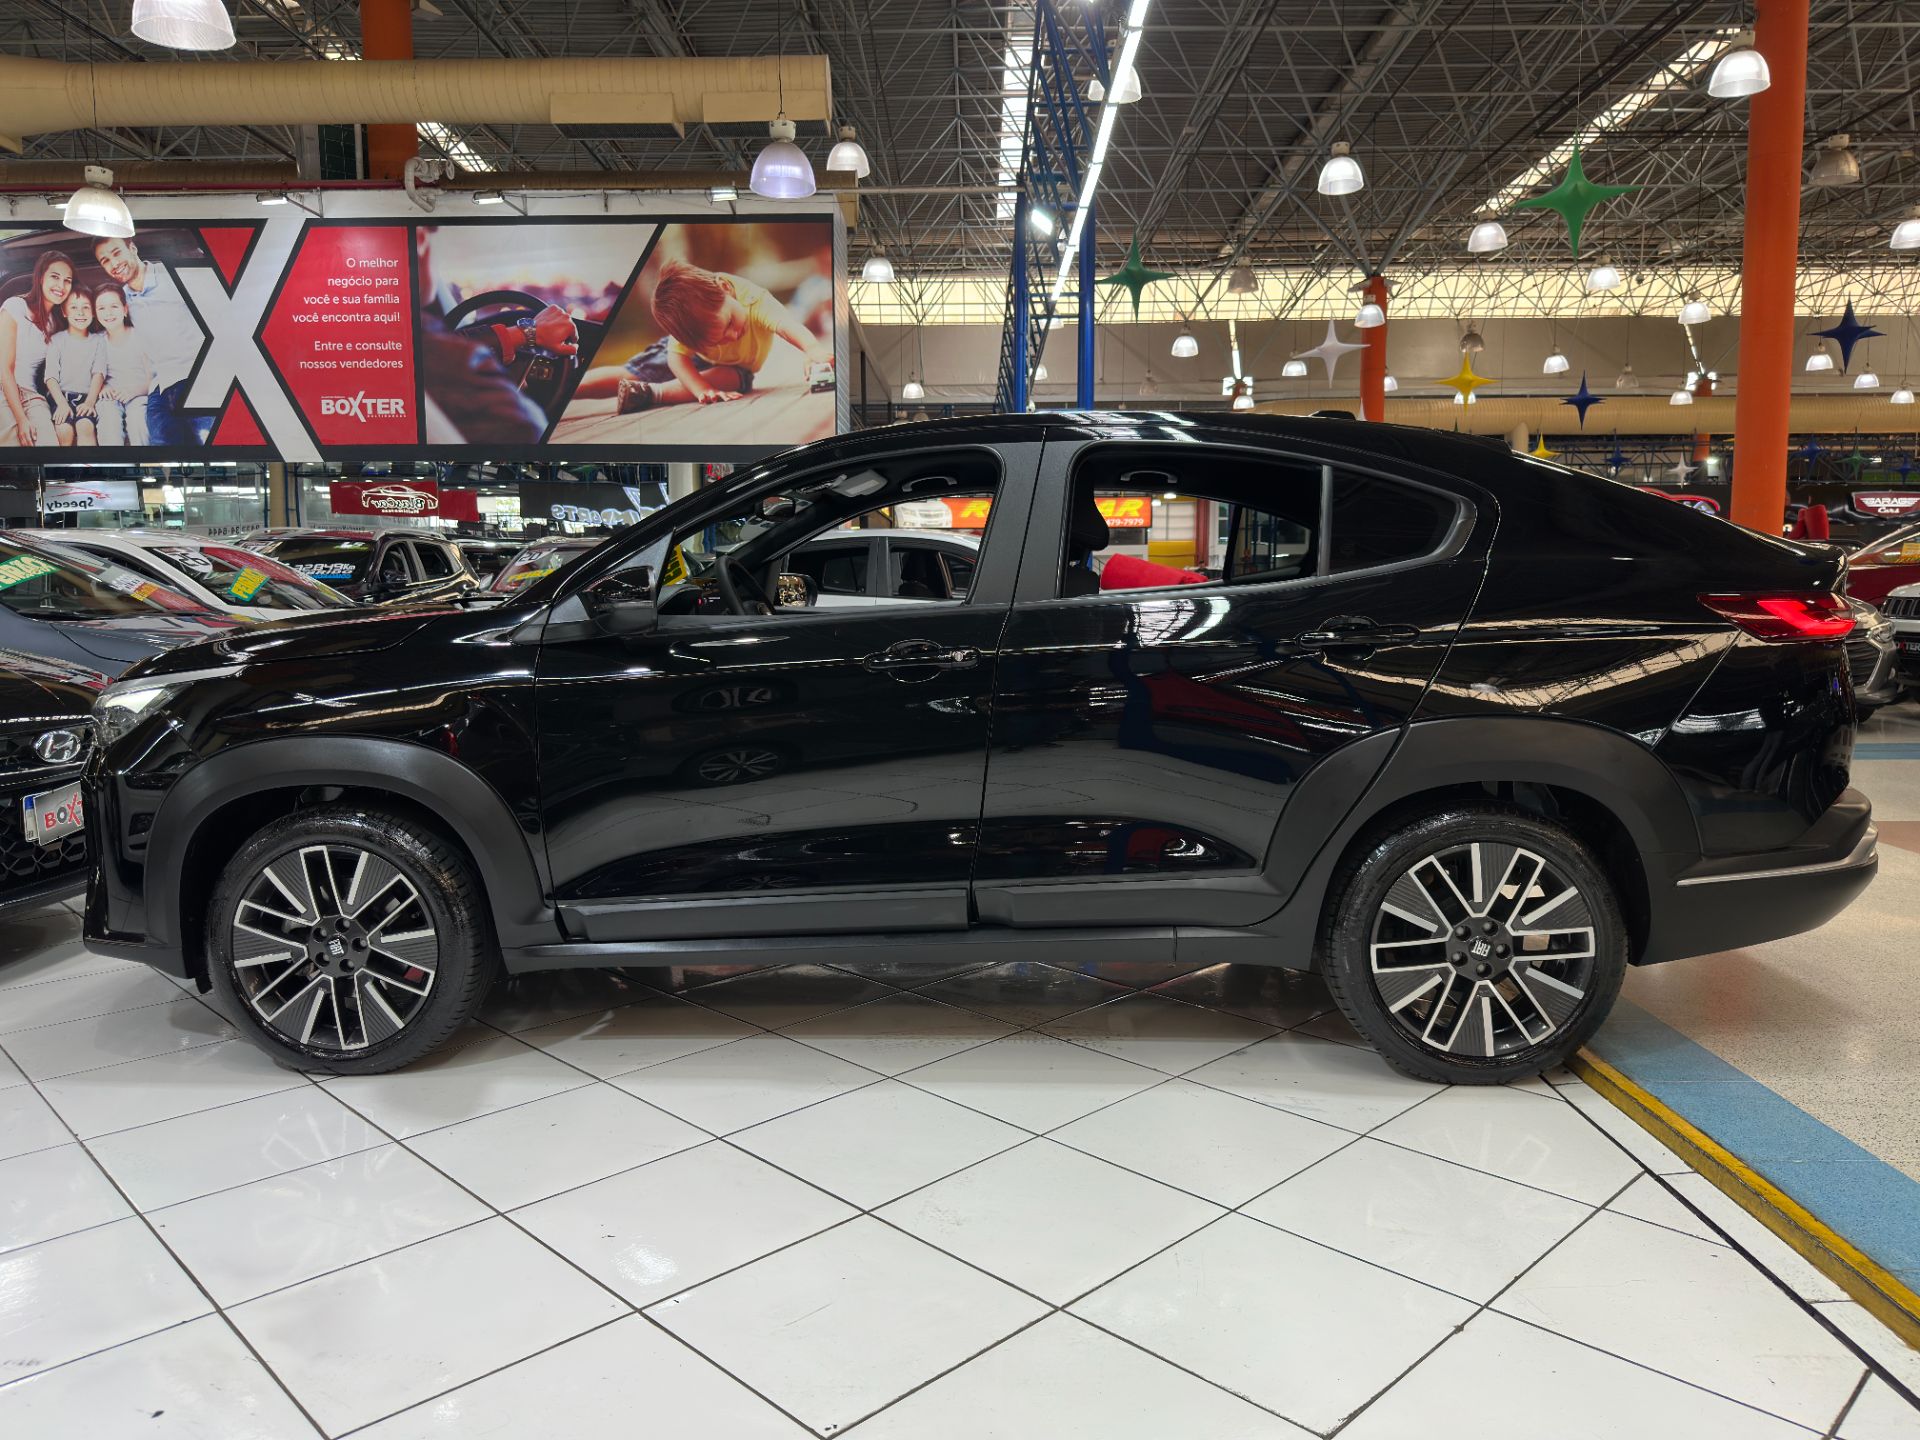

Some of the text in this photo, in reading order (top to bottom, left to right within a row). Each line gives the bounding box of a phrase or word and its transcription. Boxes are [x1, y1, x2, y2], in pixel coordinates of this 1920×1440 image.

[346, 257, 399, 268] O melhor
[327, 277, 399, 289] negócio para
[303, 293, 400, 304] você e sua família
[292, 312, 401, 324] você encontra aqui!
[314, 340, 402, 351] Entre e consulte
[300, 358, 403, 369] nossos vendedores
[320, 391, 405, 423] BOXTER
